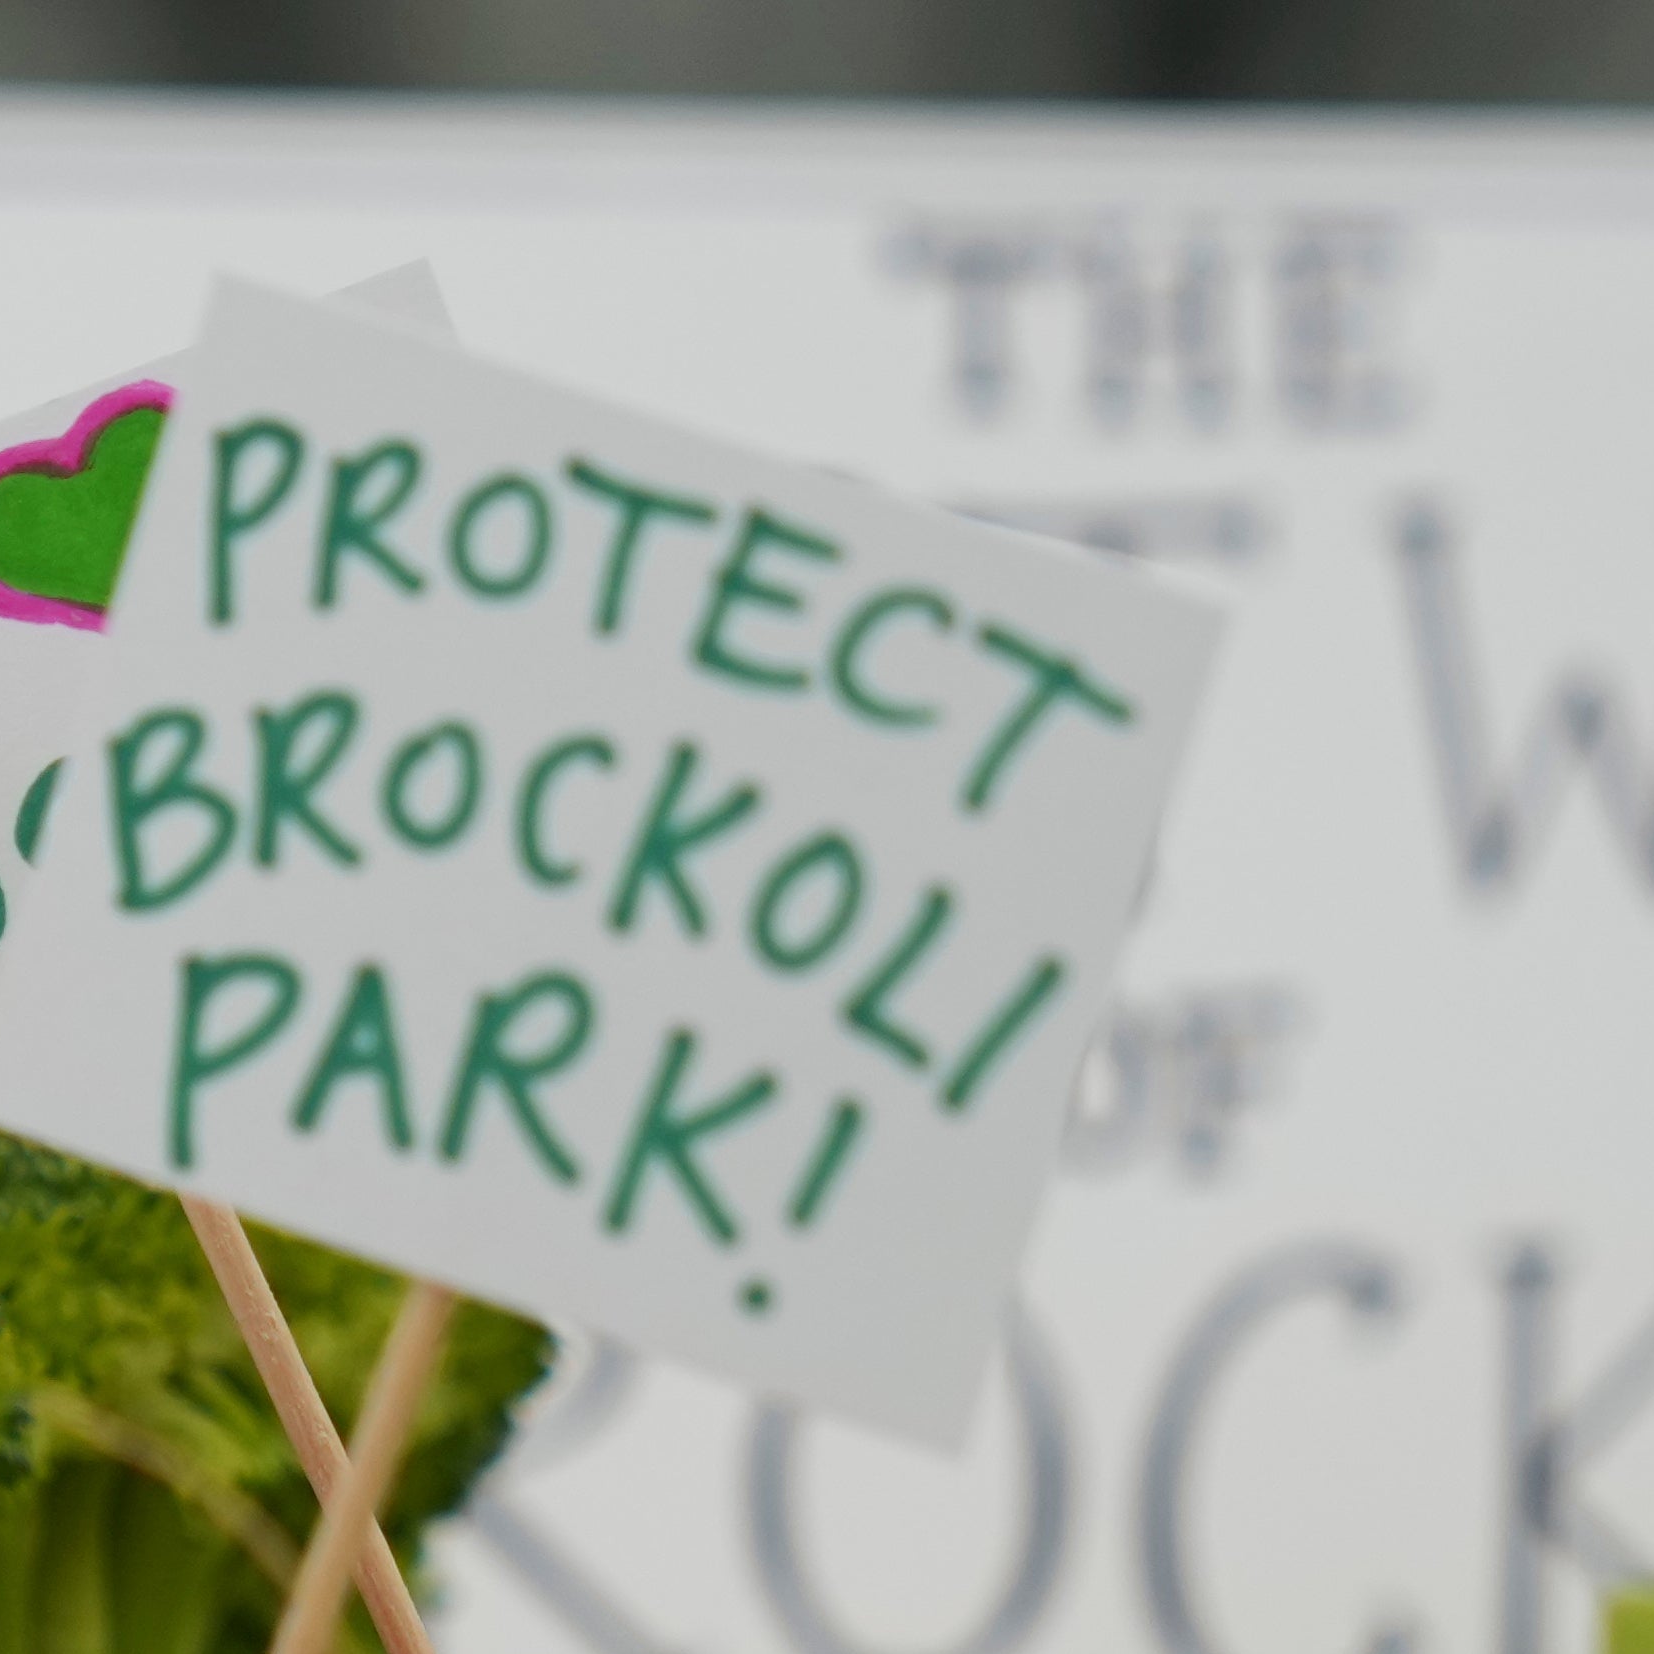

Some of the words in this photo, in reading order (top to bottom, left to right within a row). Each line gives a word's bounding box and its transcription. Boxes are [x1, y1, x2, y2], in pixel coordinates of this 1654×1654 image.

[873, 212, 1413, 435] THE
[208, 418, 1133, 812] PROTECT
[106, 690, 1067, 1112] BROCKOLI
[166, 951, 865, 1318] PARK!
